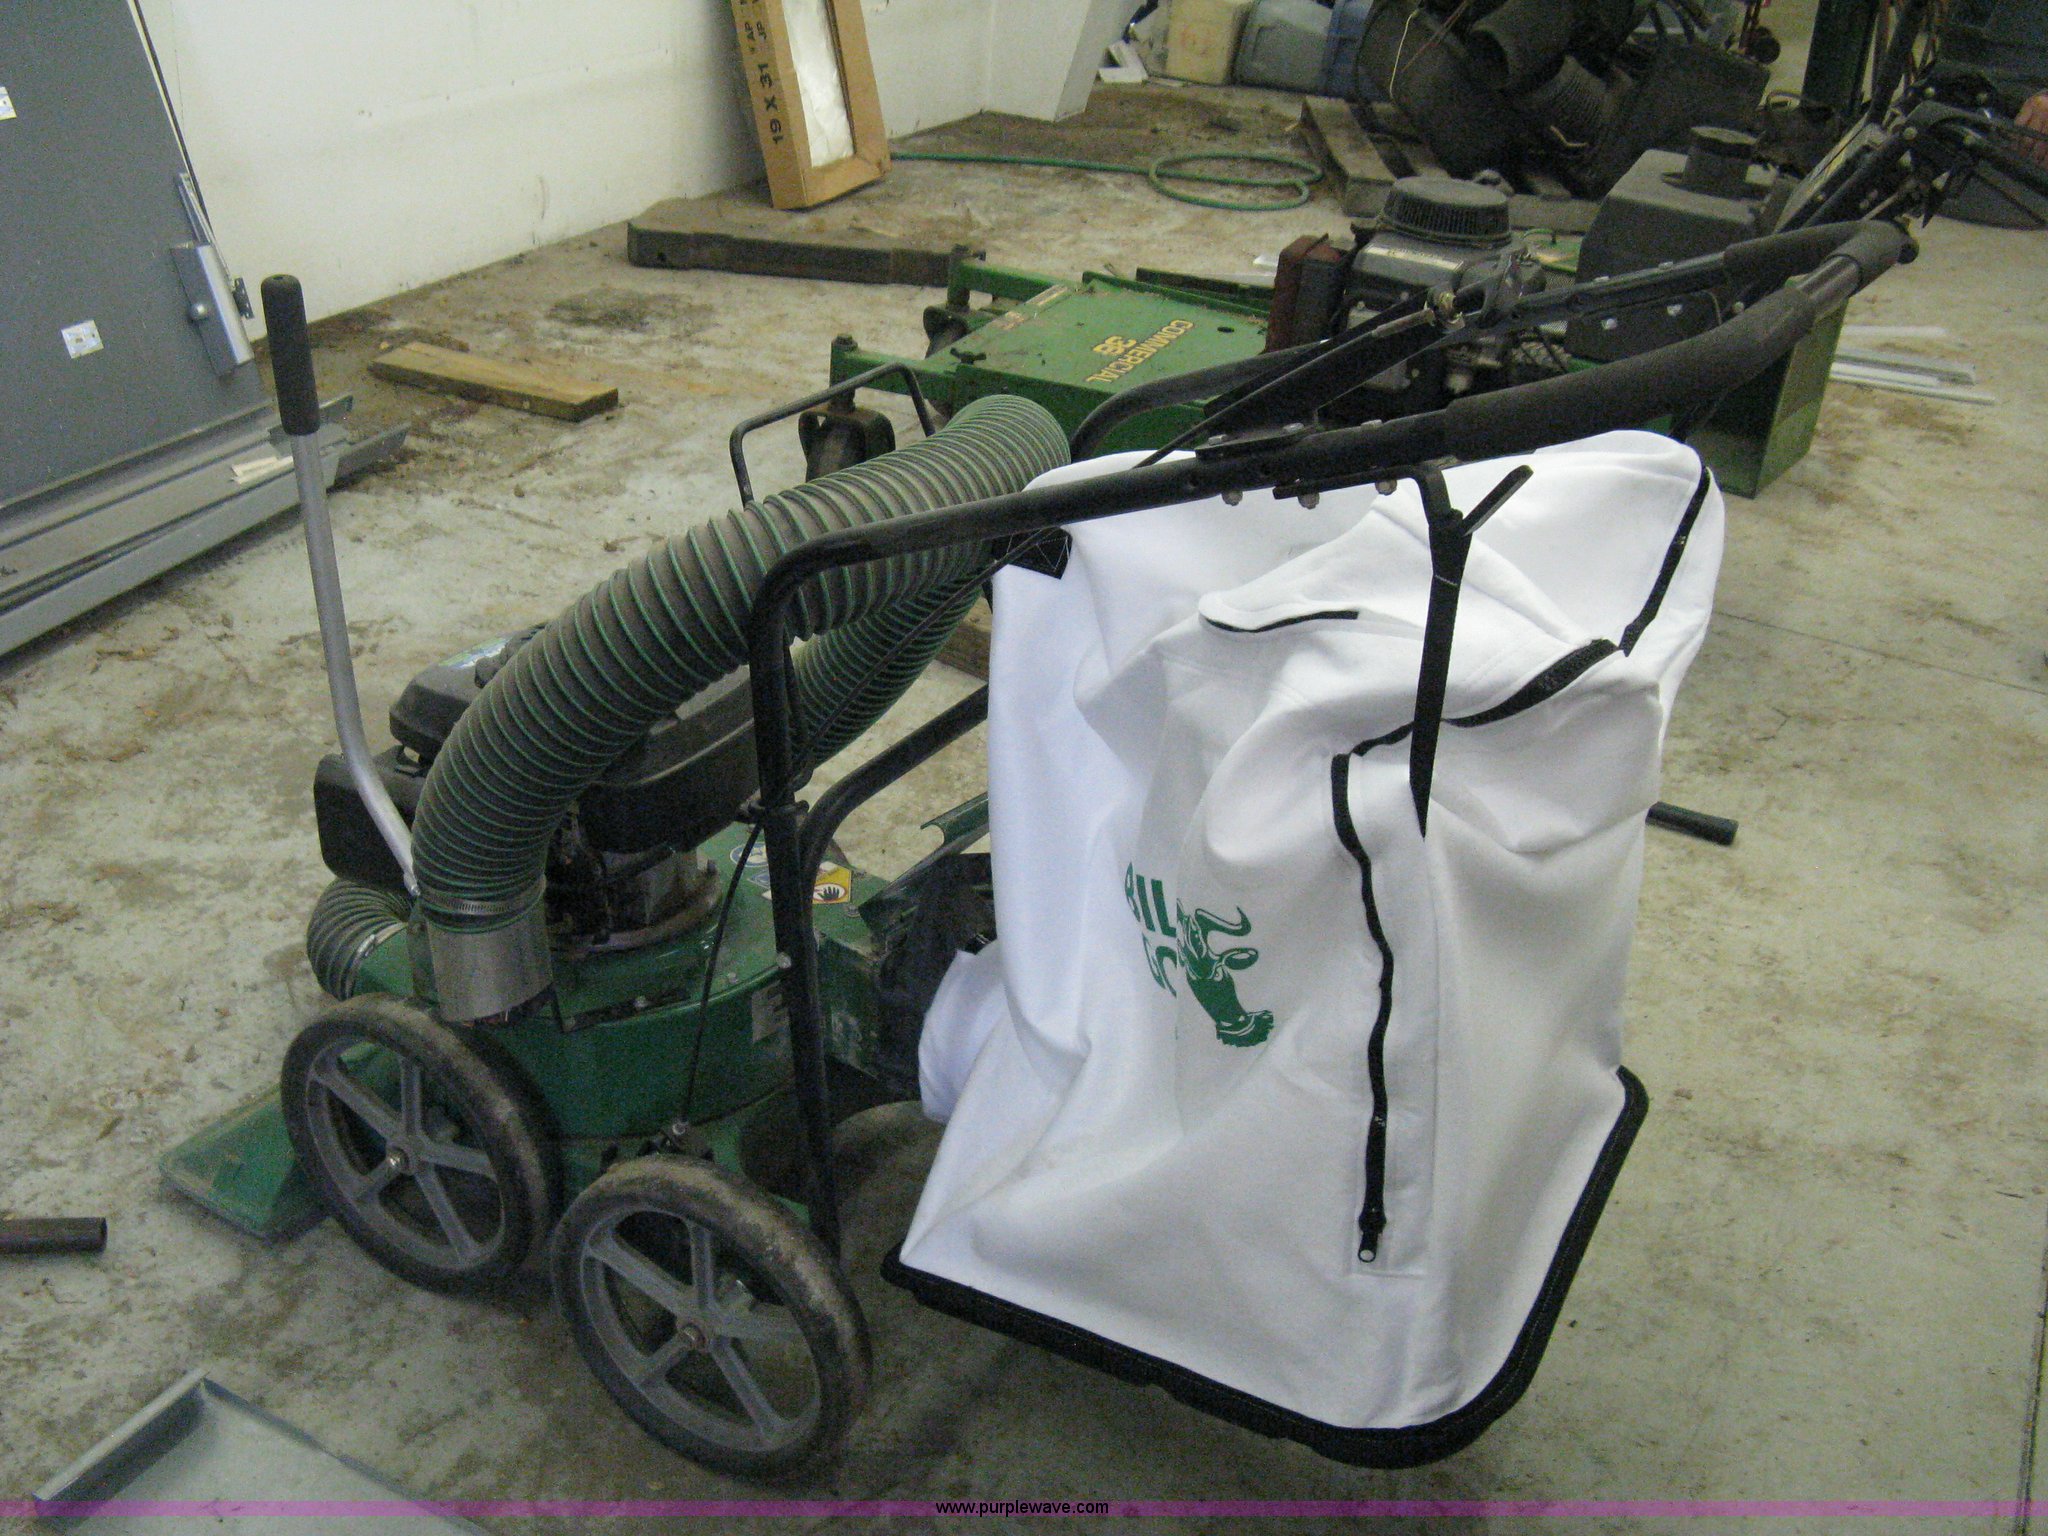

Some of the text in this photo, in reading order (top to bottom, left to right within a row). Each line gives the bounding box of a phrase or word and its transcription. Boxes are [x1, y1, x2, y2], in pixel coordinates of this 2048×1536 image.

[757, 63, 772, 88] 31
[770, 118, 783, 144] 19
[1086, 319, 1194, 383] COMMERCIAL
[1093, 335, 1137, 355] 38
